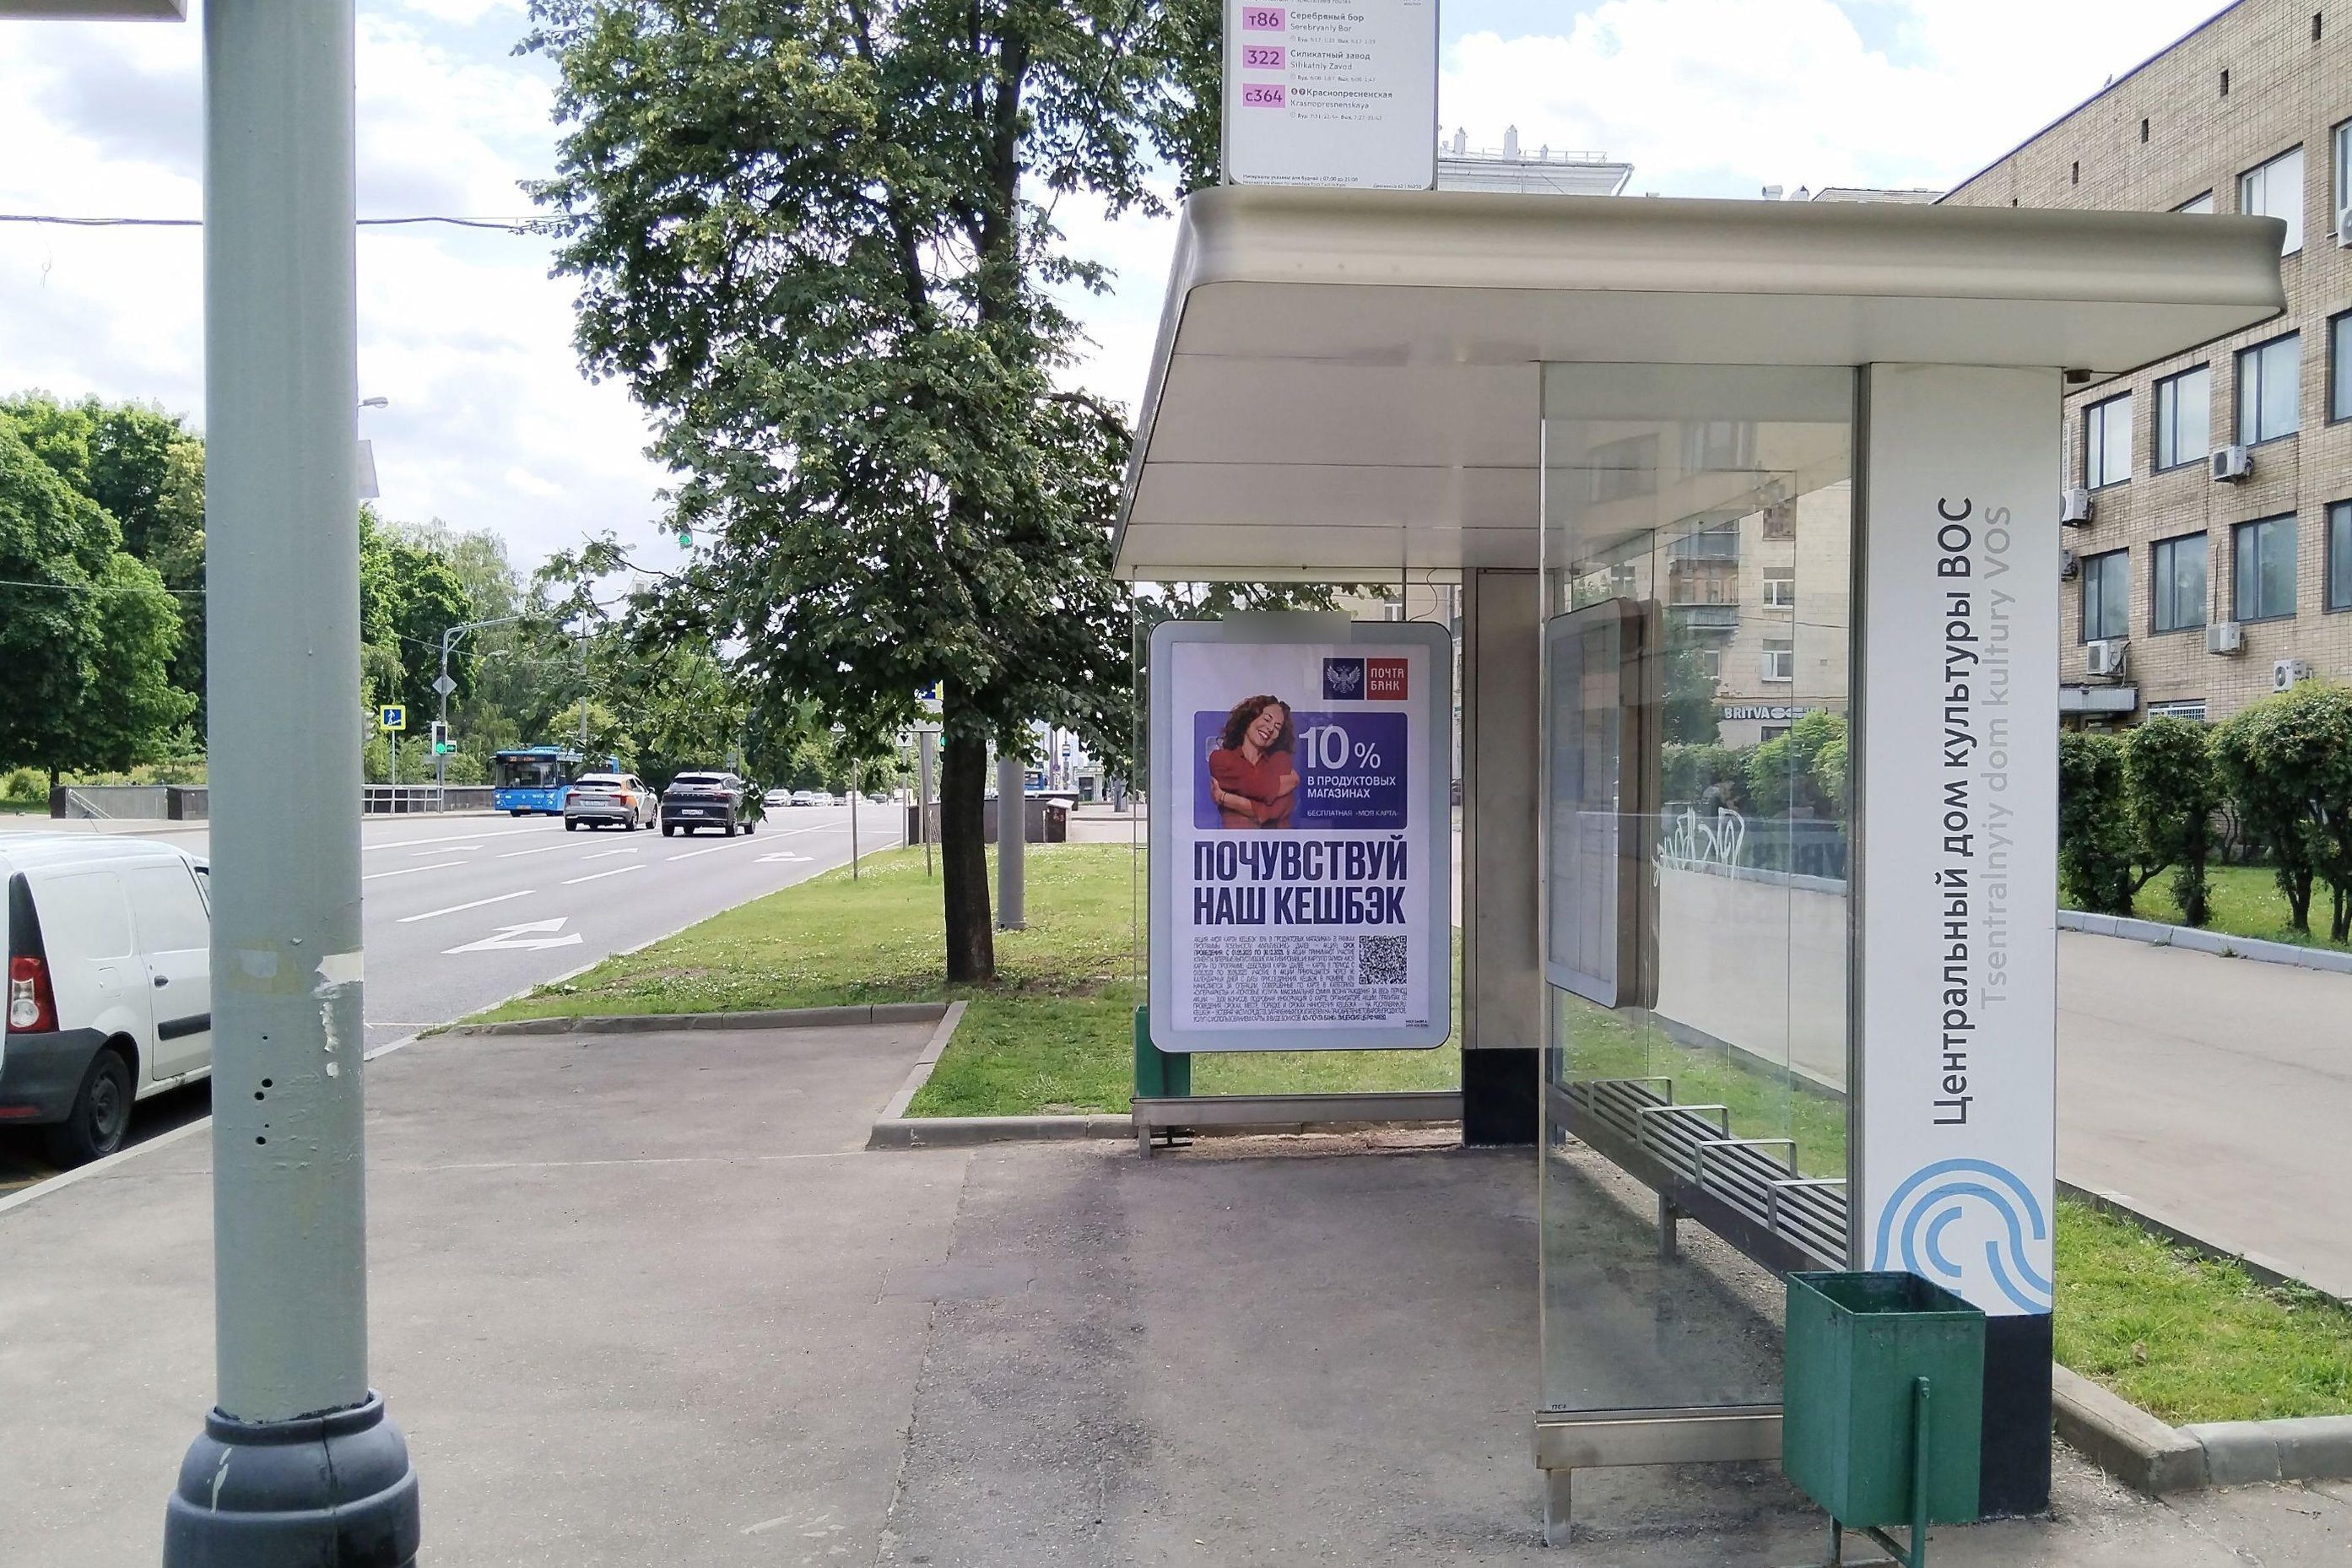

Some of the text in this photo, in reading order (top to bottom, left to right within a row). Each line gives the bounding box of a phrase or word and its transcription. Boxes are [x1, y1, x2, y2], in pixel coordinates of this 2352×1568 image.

[1249, 12, 1279, 26] т86
[1290, 12, 1364, 22] Серебряный бор
[1248, 50, 1279, 65] 322
[1290, 50, 1343, 59] Силикатный
[1246, 89, 1282, 103] с364
[1371, 668, 1404, 679] ПОЧТА
[1371, 680, 1400, 690] БАНК
[1724, 706, 1770, 719] BRITVA
[1980, 506, 2015, 1009] Tsentralnyiy dom kultury VOS
[1307, 776, 1396, 787] В ПРОДУКТОВЫХ
[1307, 788, 1371, 798] МАГАЗИНАХ
[1933, 497, 1979, 1124] Центральный дом культуры ВОС
[1194, 835, 1408, 880] ПОЧУВСТВУЙ
[1194, 886, 1406, 925] НАШ КЕШБЭК
